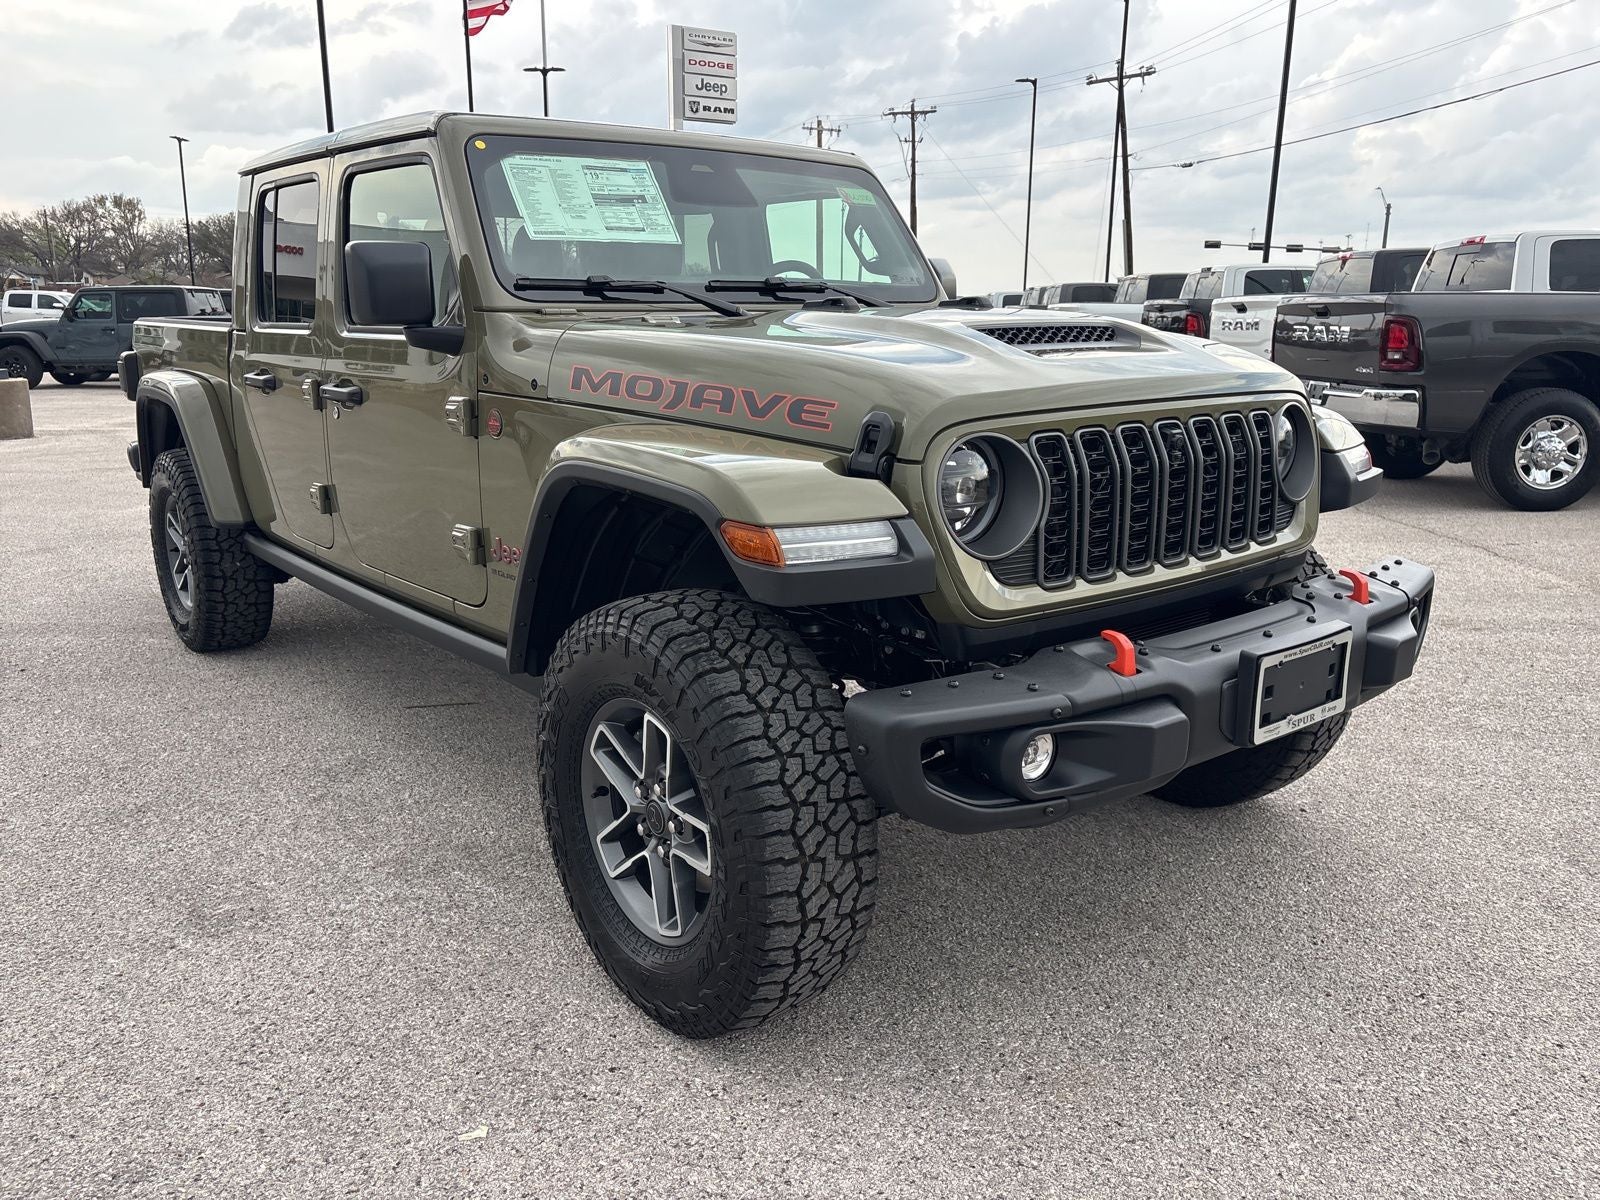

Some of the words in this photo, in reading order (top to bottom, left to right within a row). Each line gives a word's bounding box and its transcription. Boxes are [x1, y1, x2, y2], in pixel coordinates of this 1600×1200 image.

[688, 33, 734, 43] CHRYSLER
[688, 58, 734, 70] DODGE
[695, 78, 728, 96] Jeep
[702, 104, 735, 115] RAM
[1221, 318, 1261, 331] RAM
[1292, 325, 1350, 343] RAM
[569, 364, 838, 433] MOJAVE
[490, 536, 522, 567] Jee
[1283, 639, 1335, 660] www.SpurCDJR.com
[1291, 713, 1316, 729] SPUR
